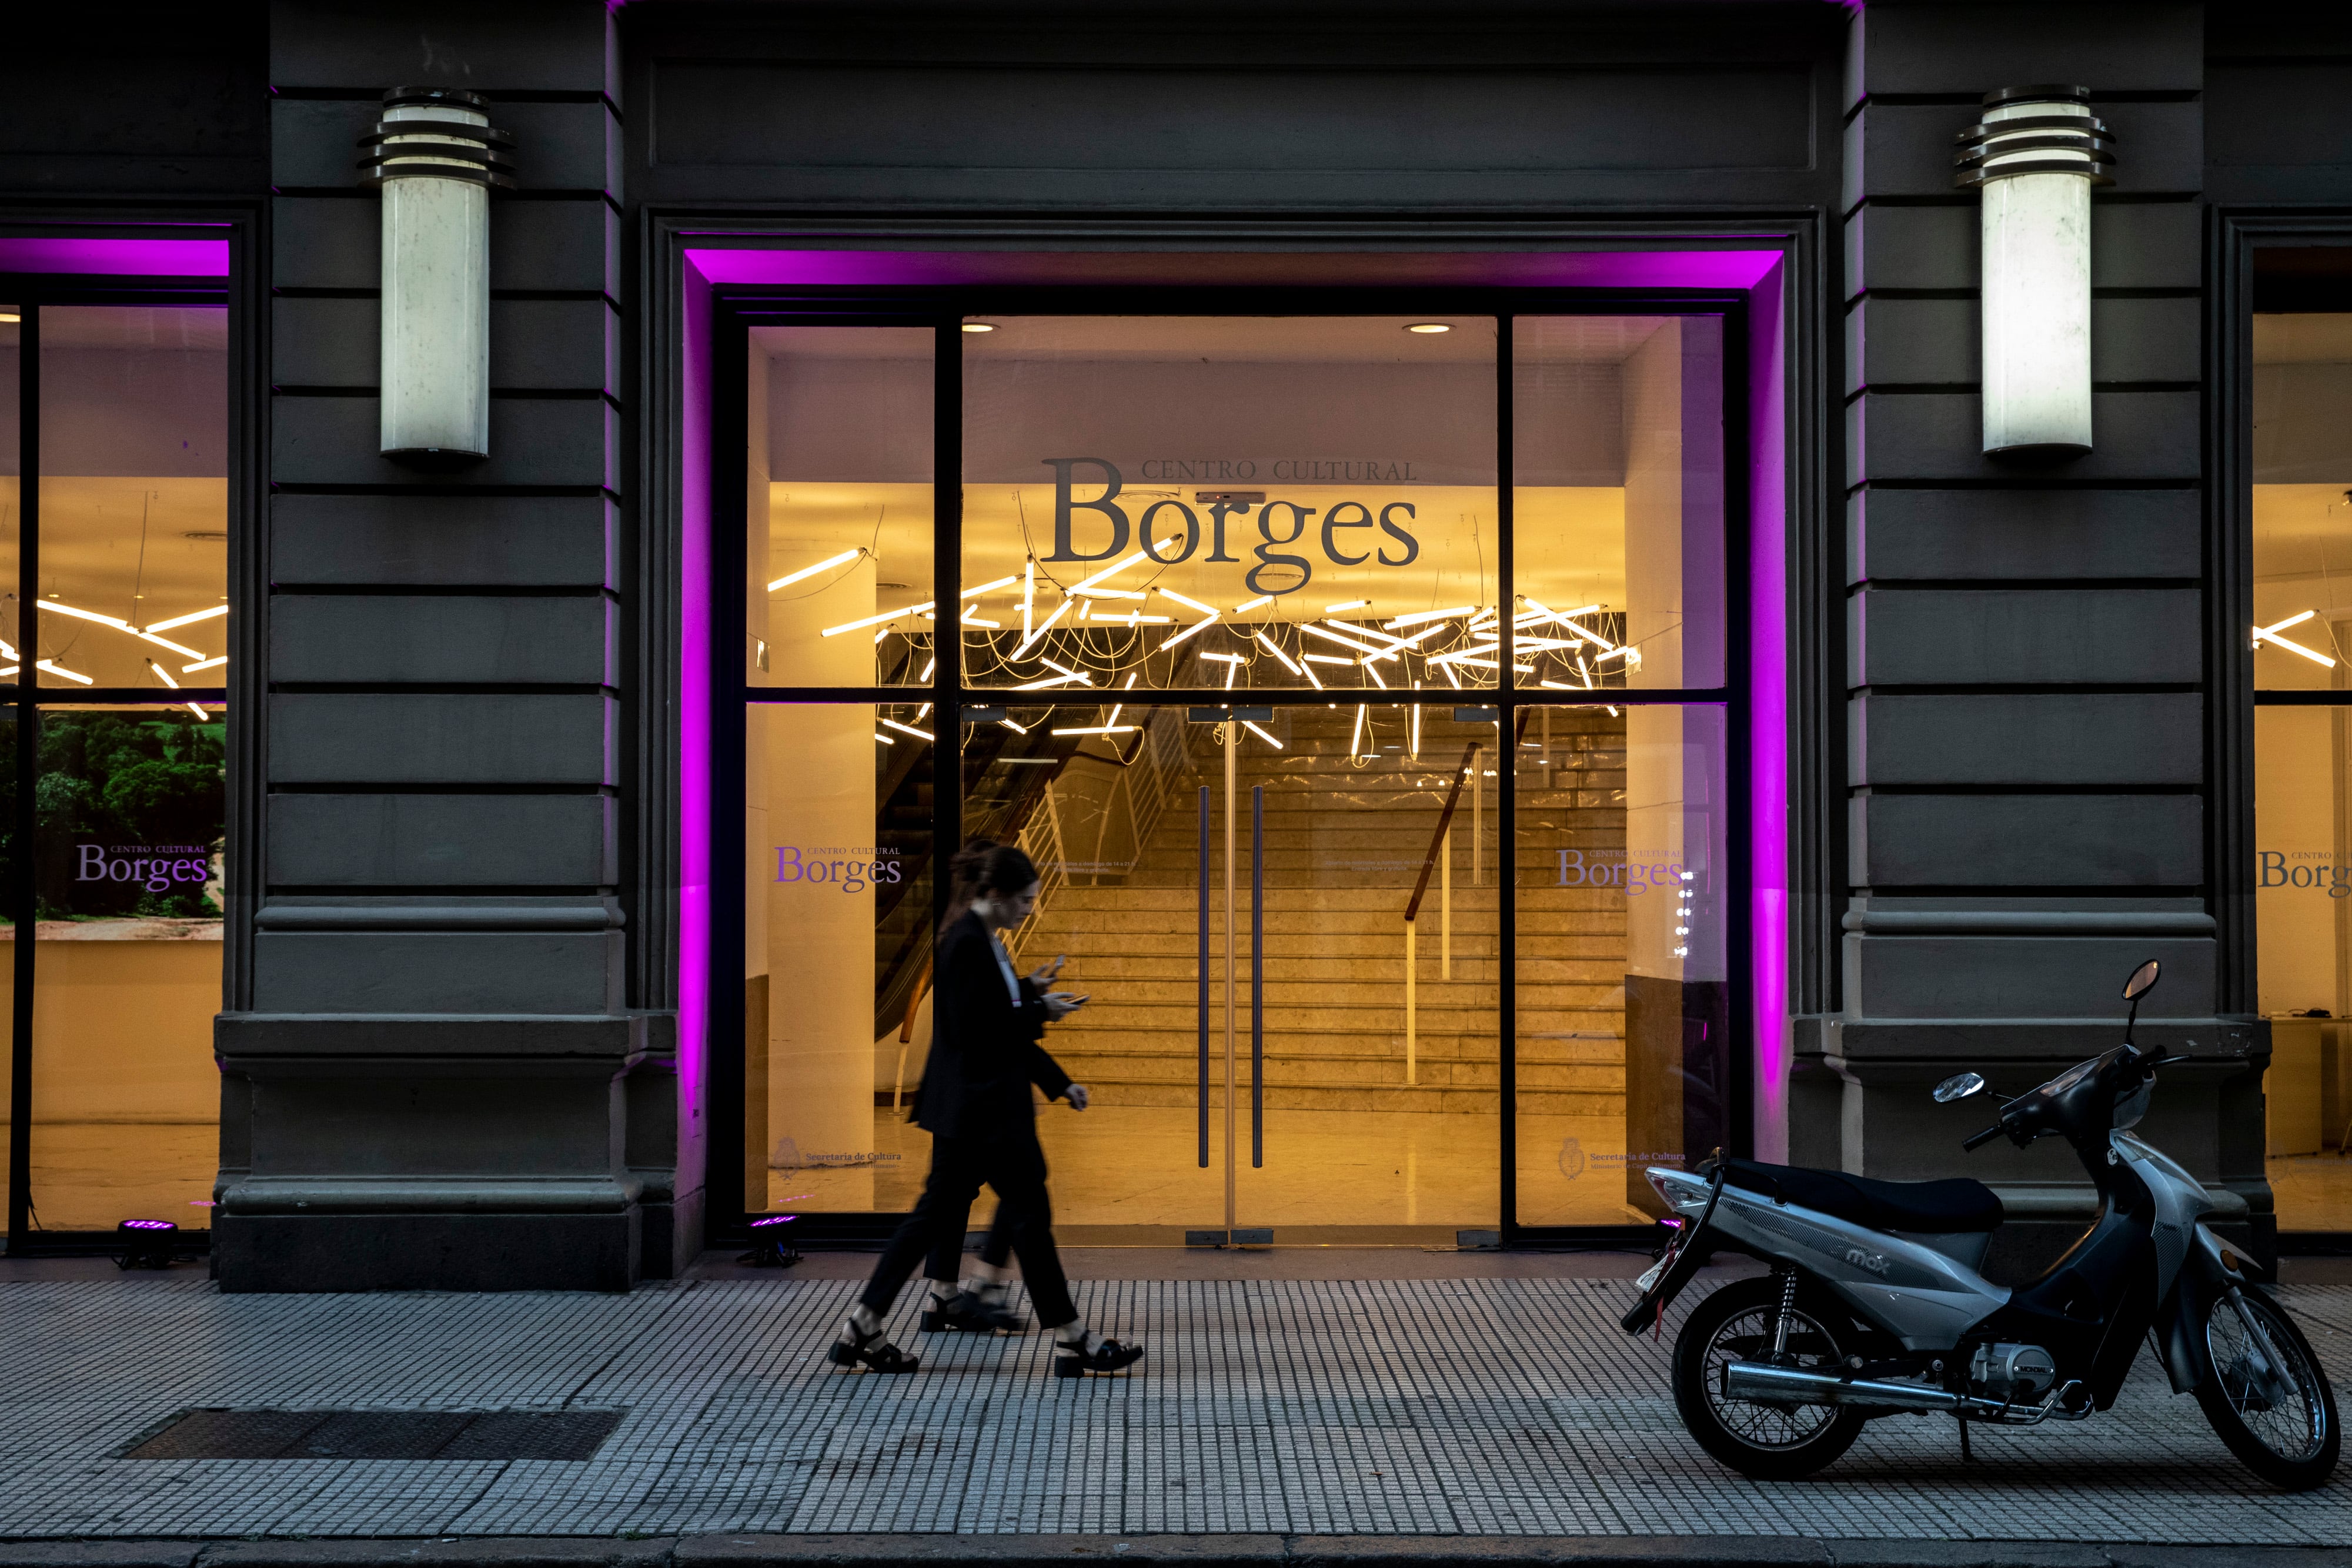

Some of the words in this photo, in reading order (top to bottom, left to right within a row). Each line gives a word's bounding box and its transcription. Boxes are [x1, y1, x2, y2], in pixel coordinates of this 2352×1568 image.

[1141, 459, 1257, 480] CENTRO
[1273, 460, 1418, 481] CULTURAL
[1040, 457, 1419, 596] Borges
[155, 845, 206, 854] CULTURAL
[75, 844, 208, 892] Borges
[773, 847, 901, 893] Borges
[1555, 849, 1683, 896] Borges
[854, 1152, 865, 1161] de
[868, 1152, 901, 1161] Cultura
[1639, 1152, 1649, 1161] de
[1652, 1152, 1686, 1161] Cultura
[1846, 1249, 1890, 1275] max
